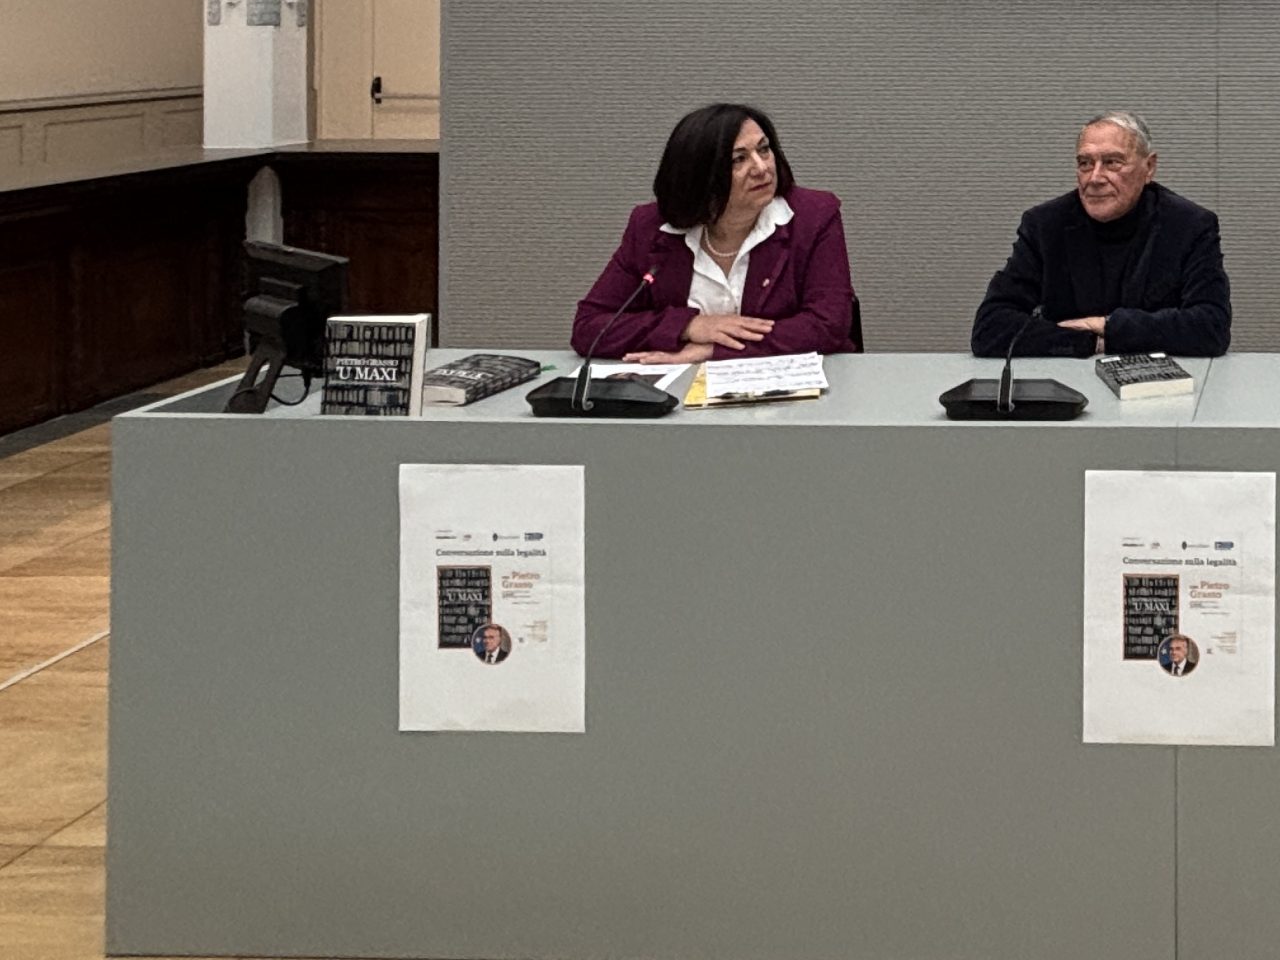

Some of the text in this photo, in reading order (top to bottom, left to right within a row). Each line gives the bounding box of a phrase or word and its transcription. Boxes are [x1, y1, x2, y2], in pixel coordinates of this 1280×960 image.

[336, 357, 365, 367] PIETRO
[355, 367, 398, 382] MAXI
[496, 548, 515, 557] sulla
[1185, 558, 1204, 566] sulla
[511, 571, 541, 580] Pietro
[1200, 581, 1230, 590] Pietro
[460, 593, 483, 601] MAXI
[1146, 602, 1170, 612] MAXI
